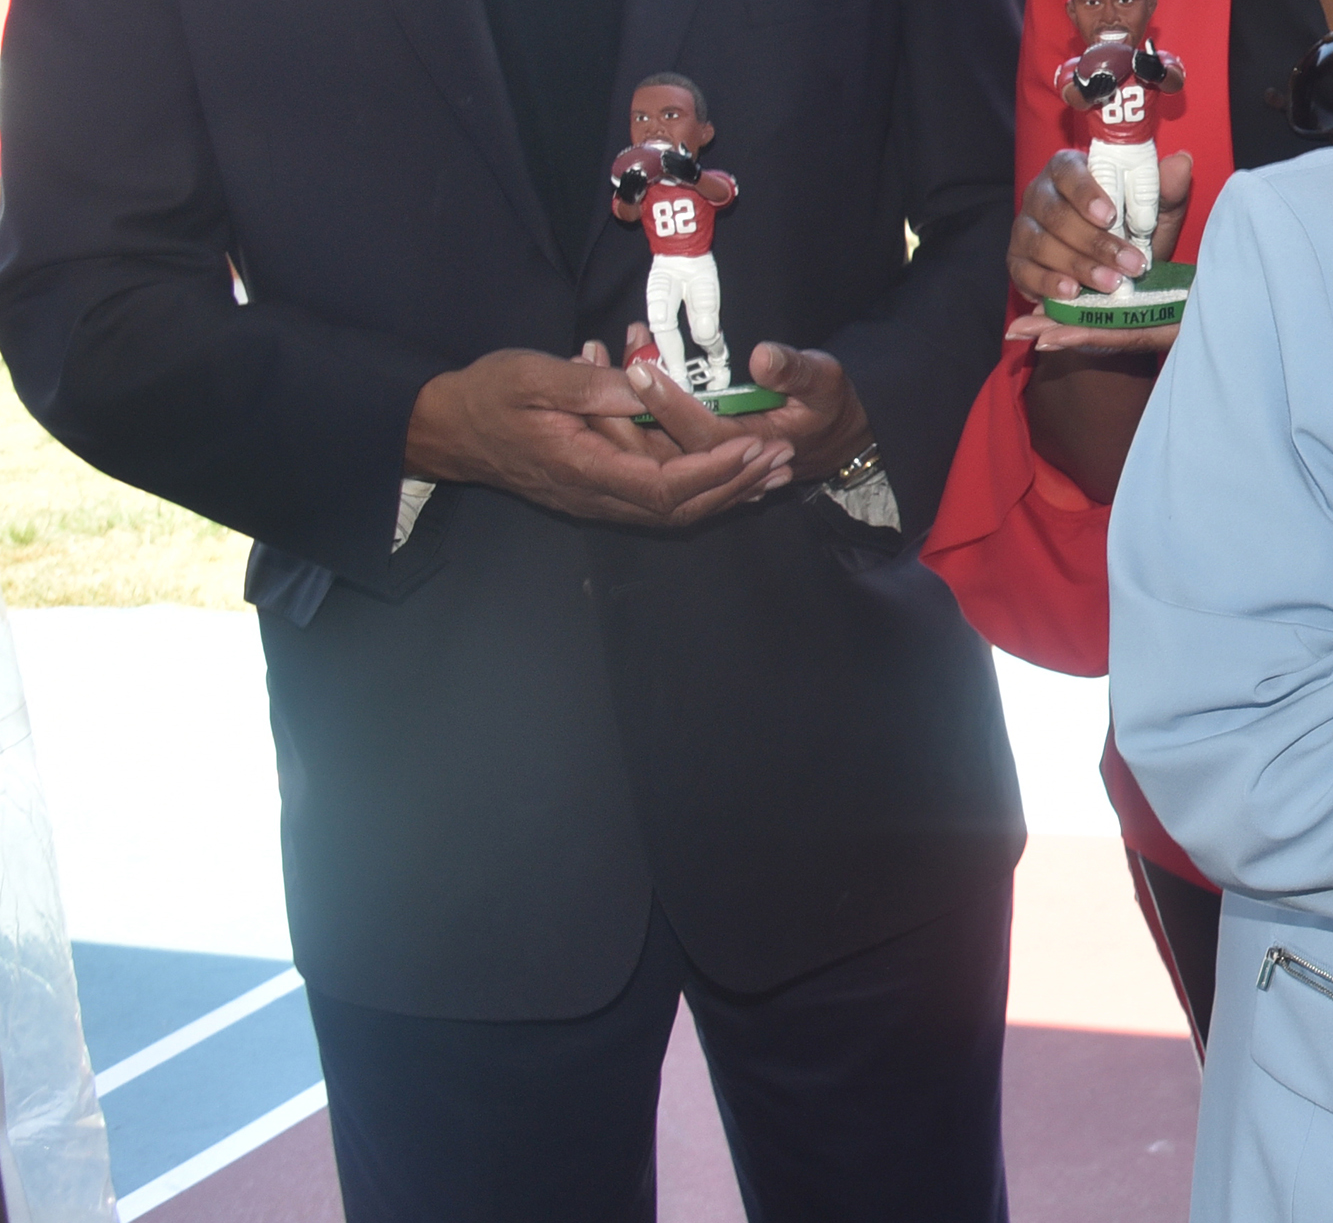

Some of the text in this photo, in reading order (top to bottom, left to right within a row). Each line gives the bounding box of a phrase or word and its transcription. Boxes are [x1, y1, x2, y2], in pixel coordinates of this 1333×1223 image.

[1101, 84, 1145, 124] 82
[652, 198, 697, 238] 82
[1077, 305, 1175, 325] JOHN TAYLOR
